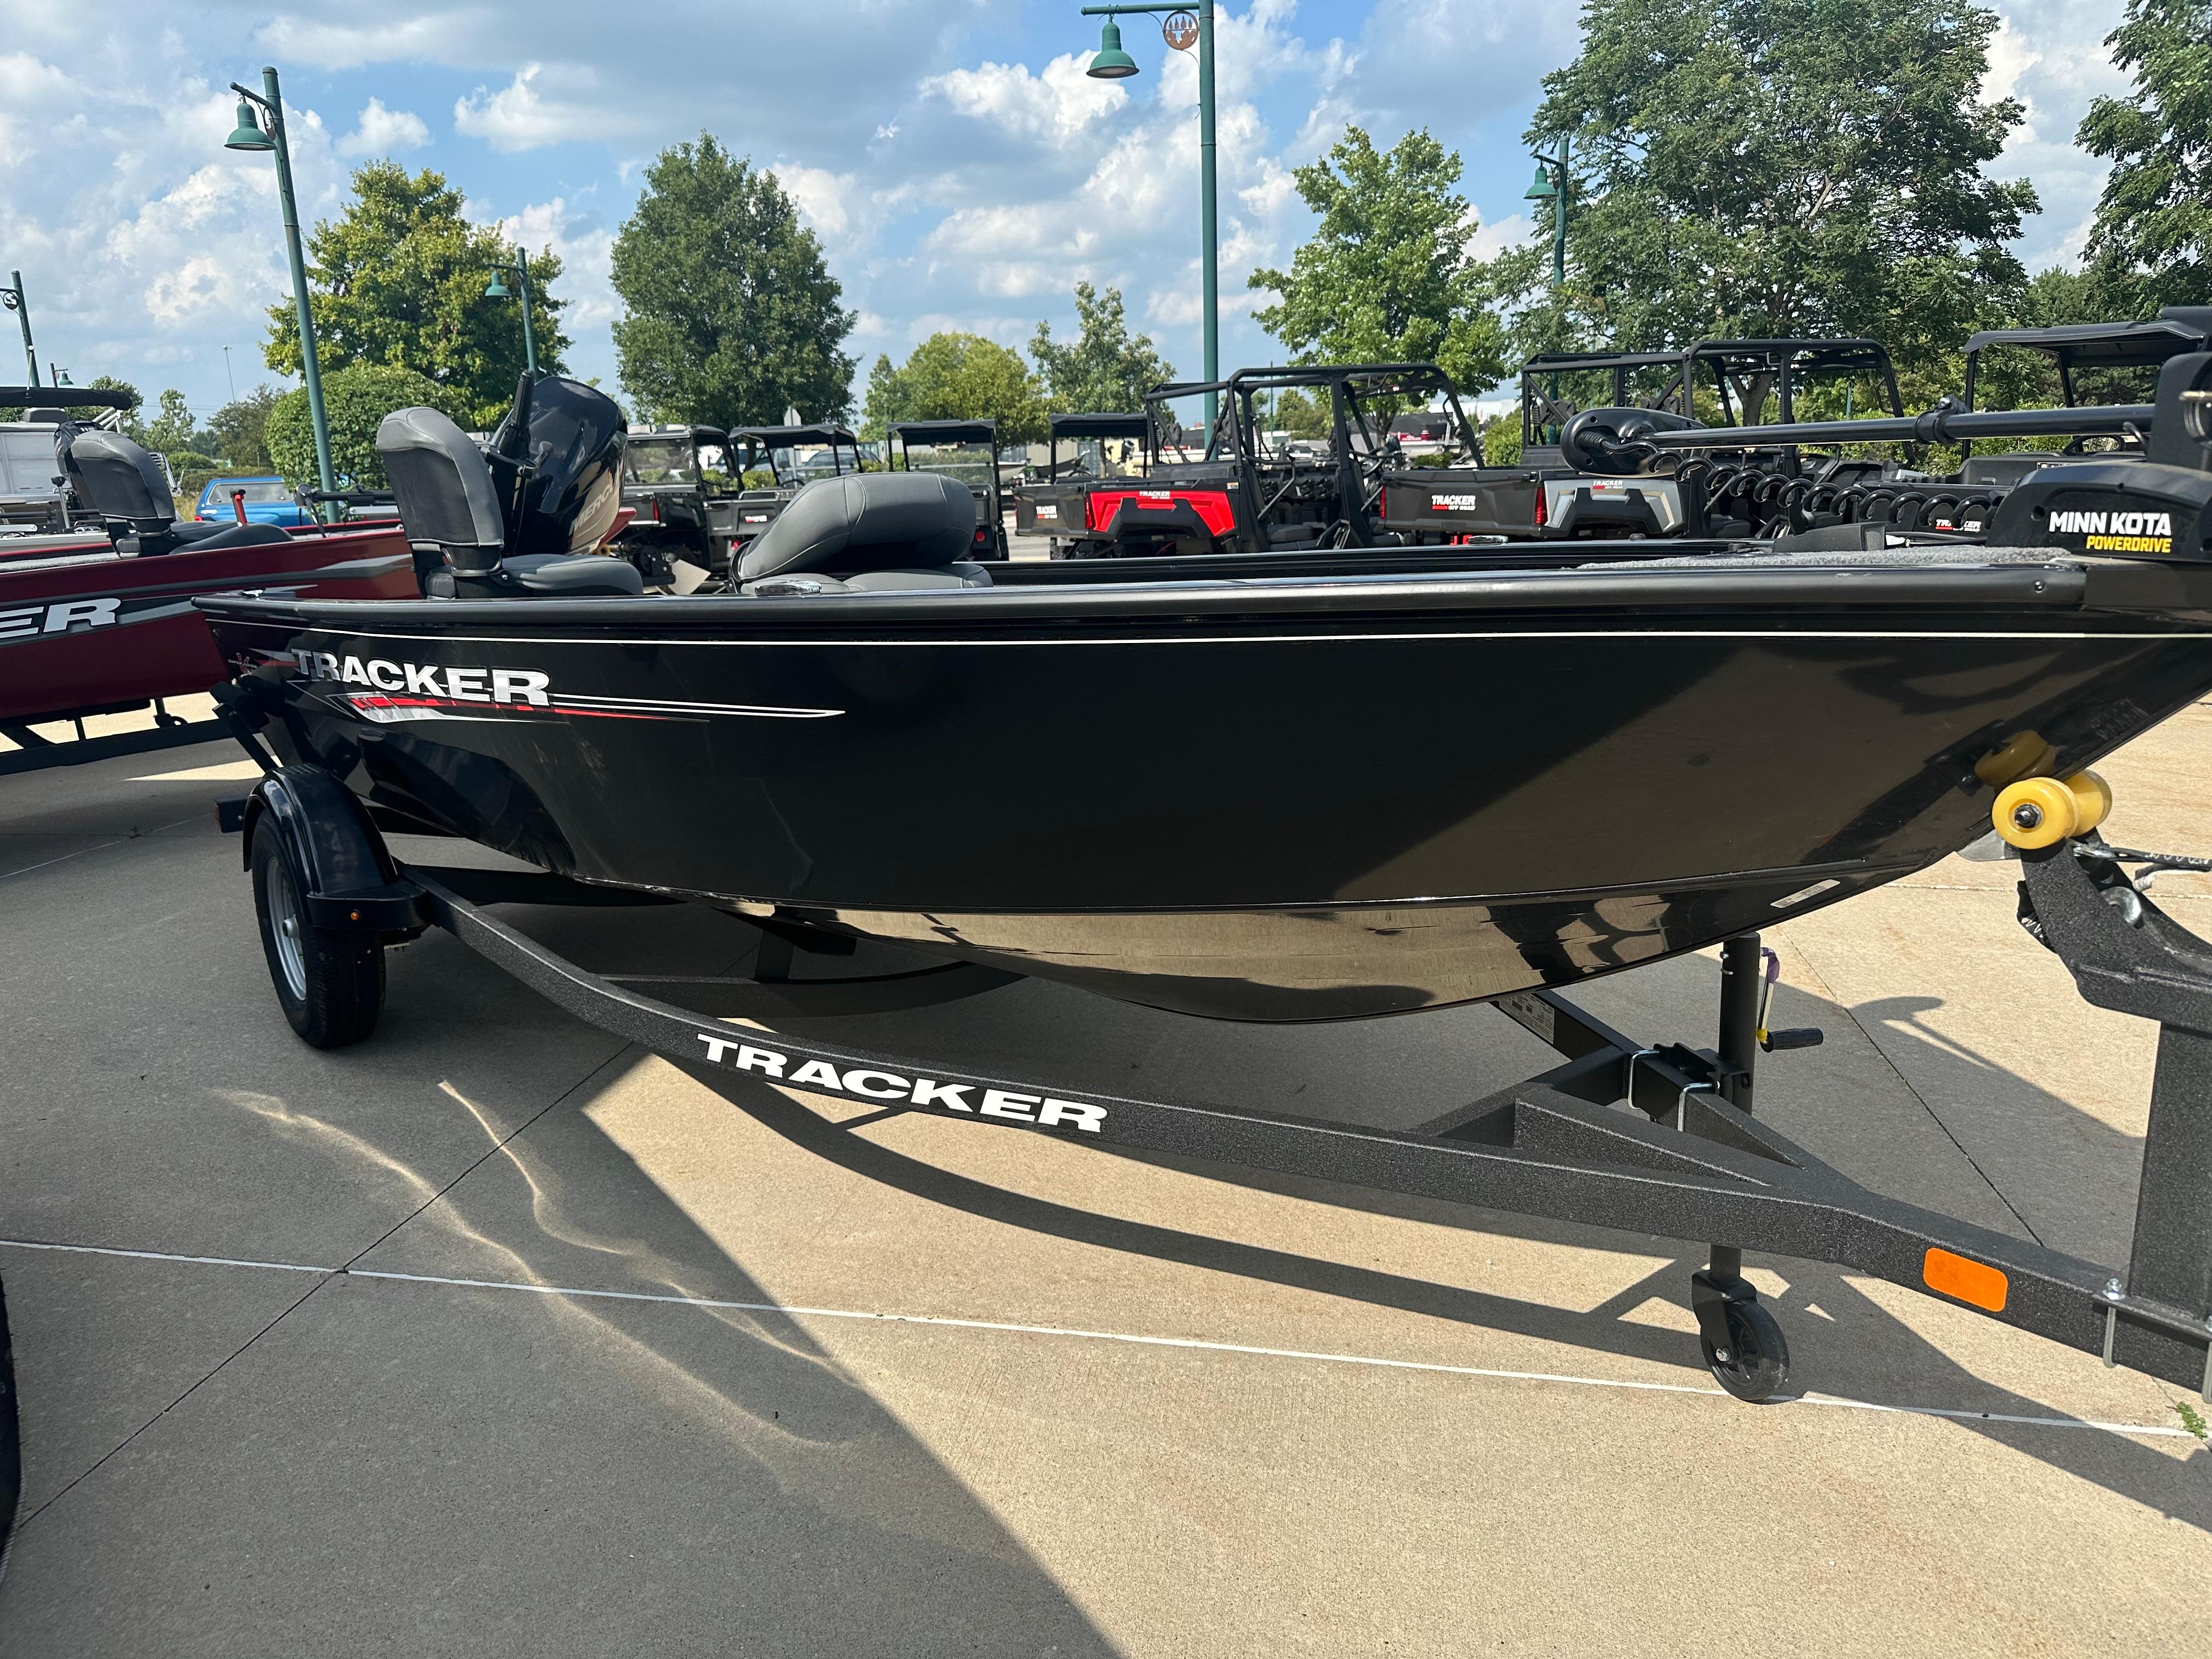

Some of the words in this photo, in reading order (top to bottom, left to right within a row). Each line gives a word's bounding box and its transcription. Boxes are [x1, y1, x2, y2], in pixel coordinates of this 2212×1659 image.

[1431, 495, 1476, 505] TRACKER
[2049, 511, 2107, 533] MINN
[2109, 512, 2171, 535] KOTA
[2086, 535, 2172, 553] POWERDRIVE
[291, 648, 550, 706] TRACKER
[697, 1034, 1108, 1132] TRACKER
